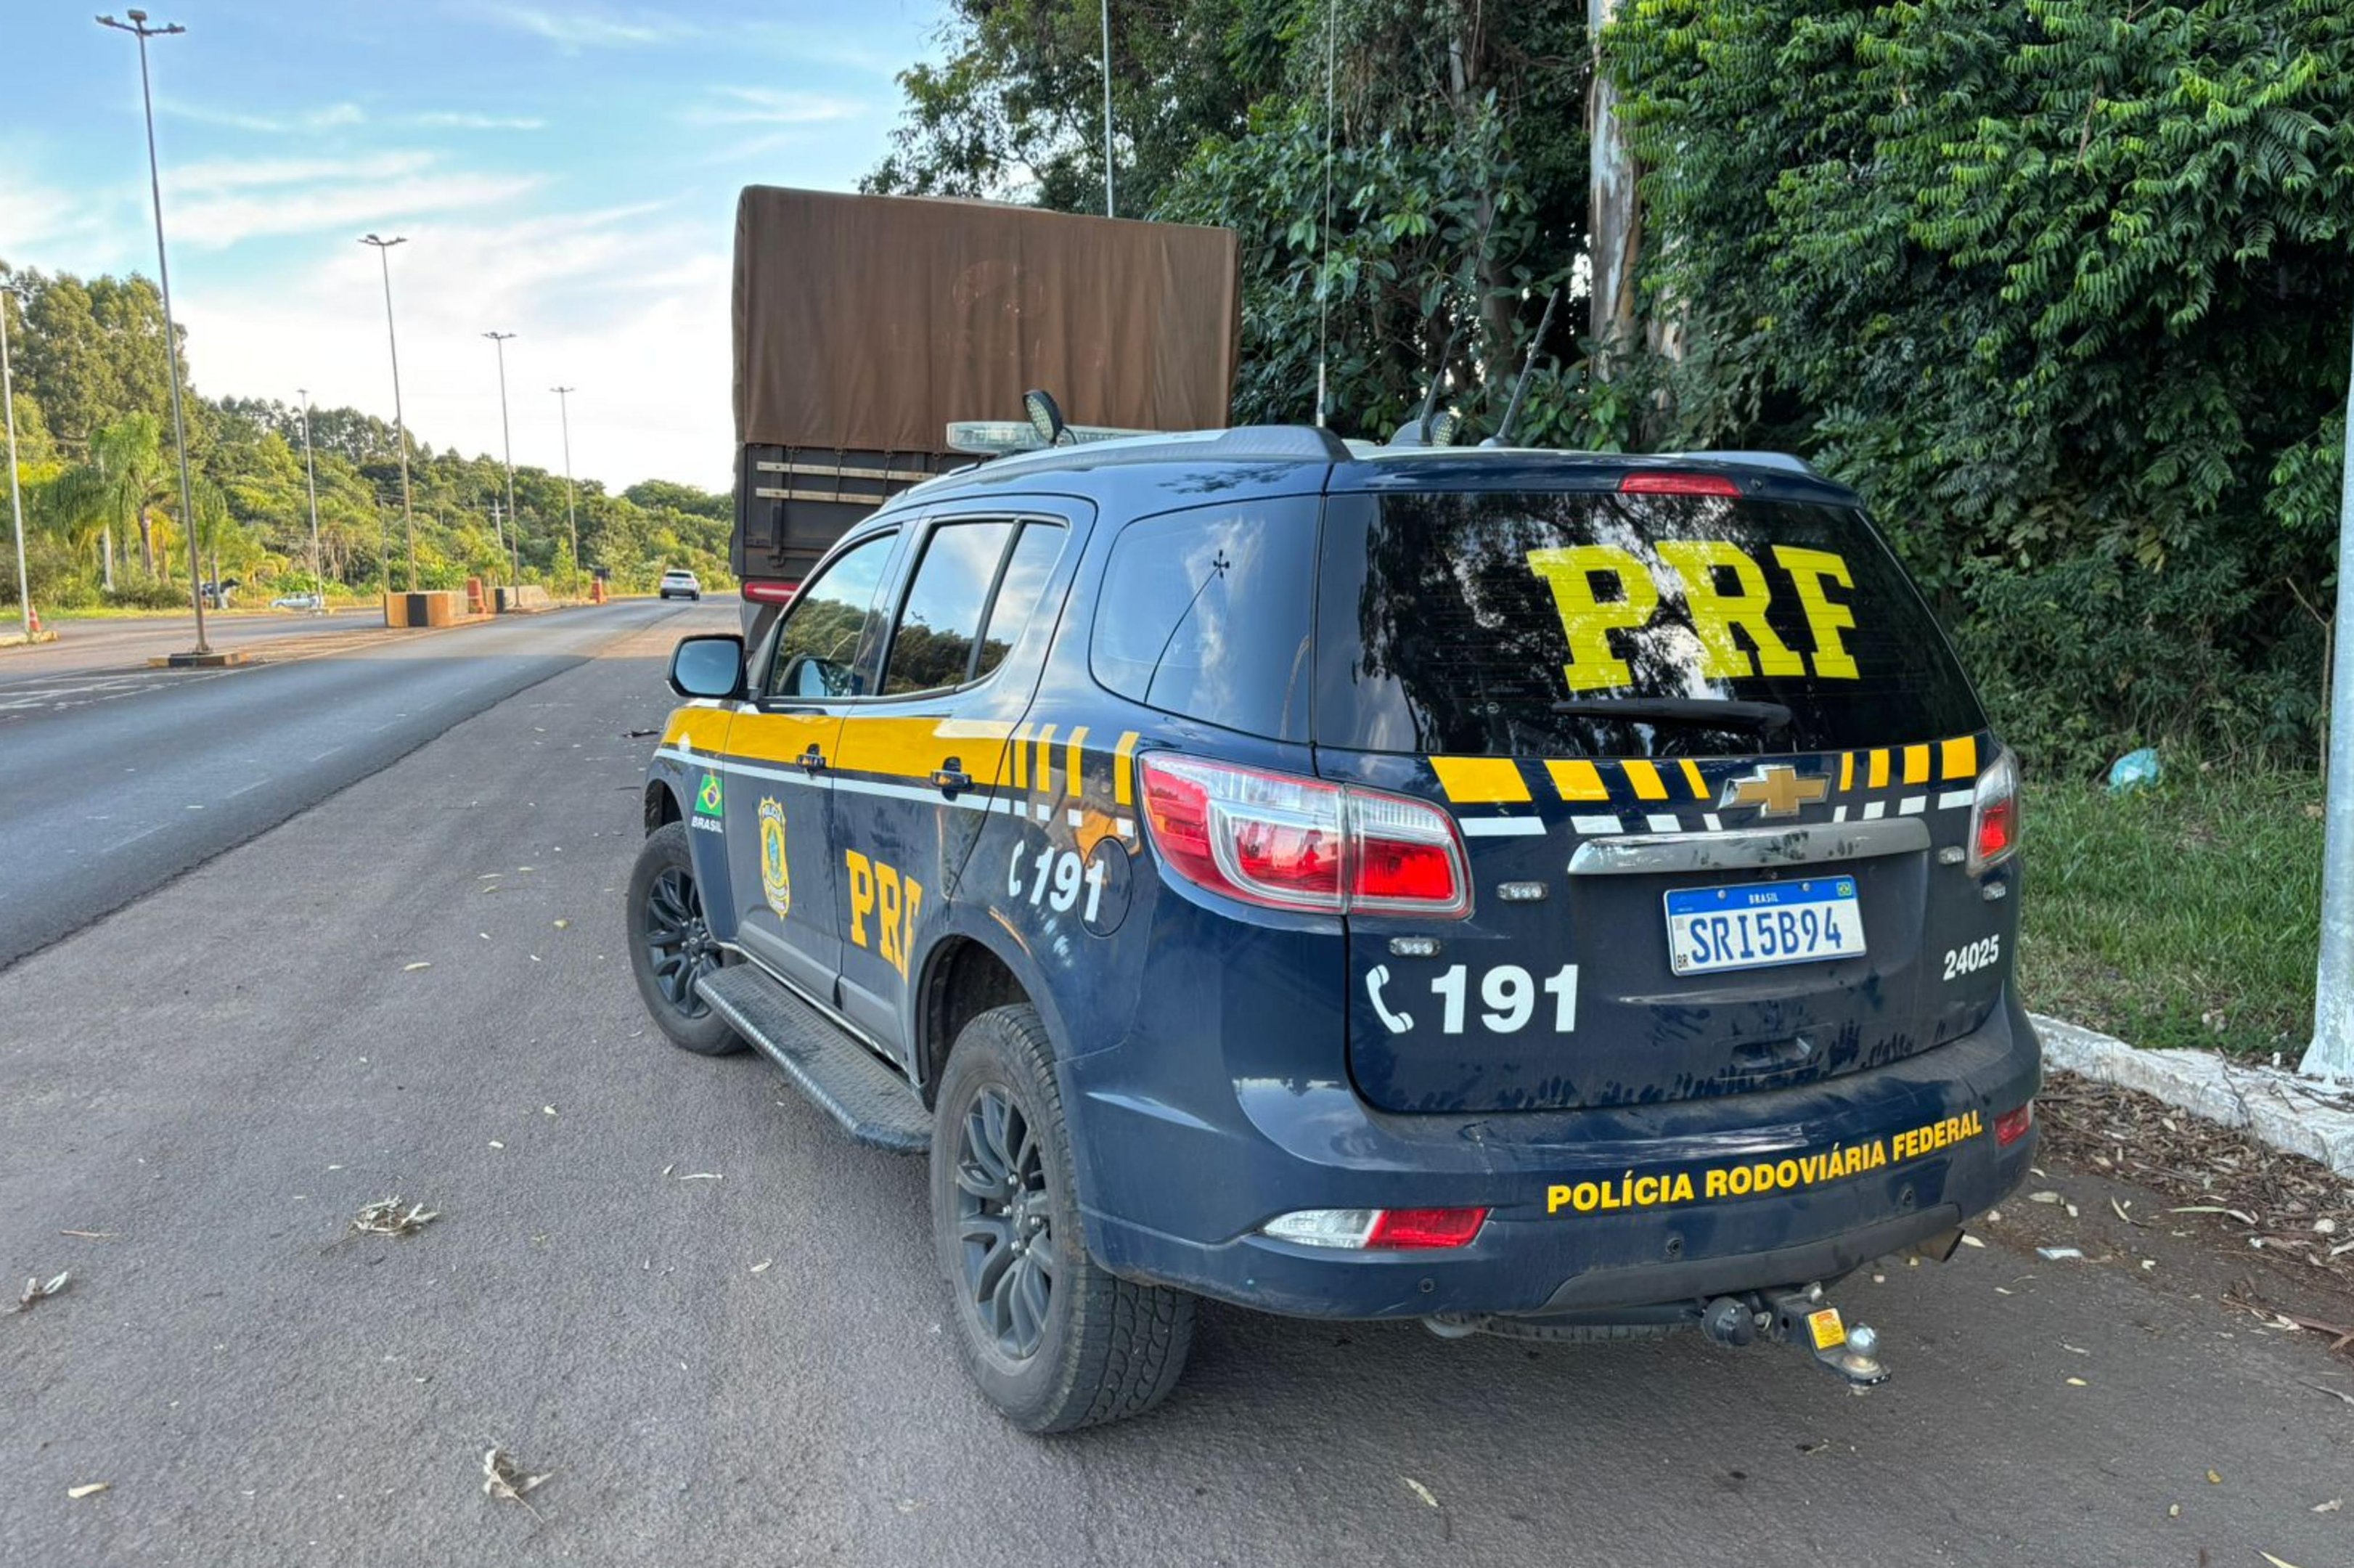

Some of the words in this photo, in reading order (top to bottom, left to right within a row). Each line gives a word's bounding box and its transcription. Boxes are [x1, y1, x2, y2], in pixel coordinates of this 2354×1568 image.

[1526, 540, 1860, 692] PRF
[1030, 846, 1104, 923] 191
[1749, 892, 1779, 904] BRASIL
[1690, 907, 1842, 964] SRI5B94
[1943, 934, 2000, 981] 24025
[1431, 964, 1579, 1034] 191
[1548, 1171, 1693, 1212] POLÍCIA
[1706, 1143, 1886, 1198] RODOVIÁRIA
[1892, 1110, 1982, 1161] FEDERAL
